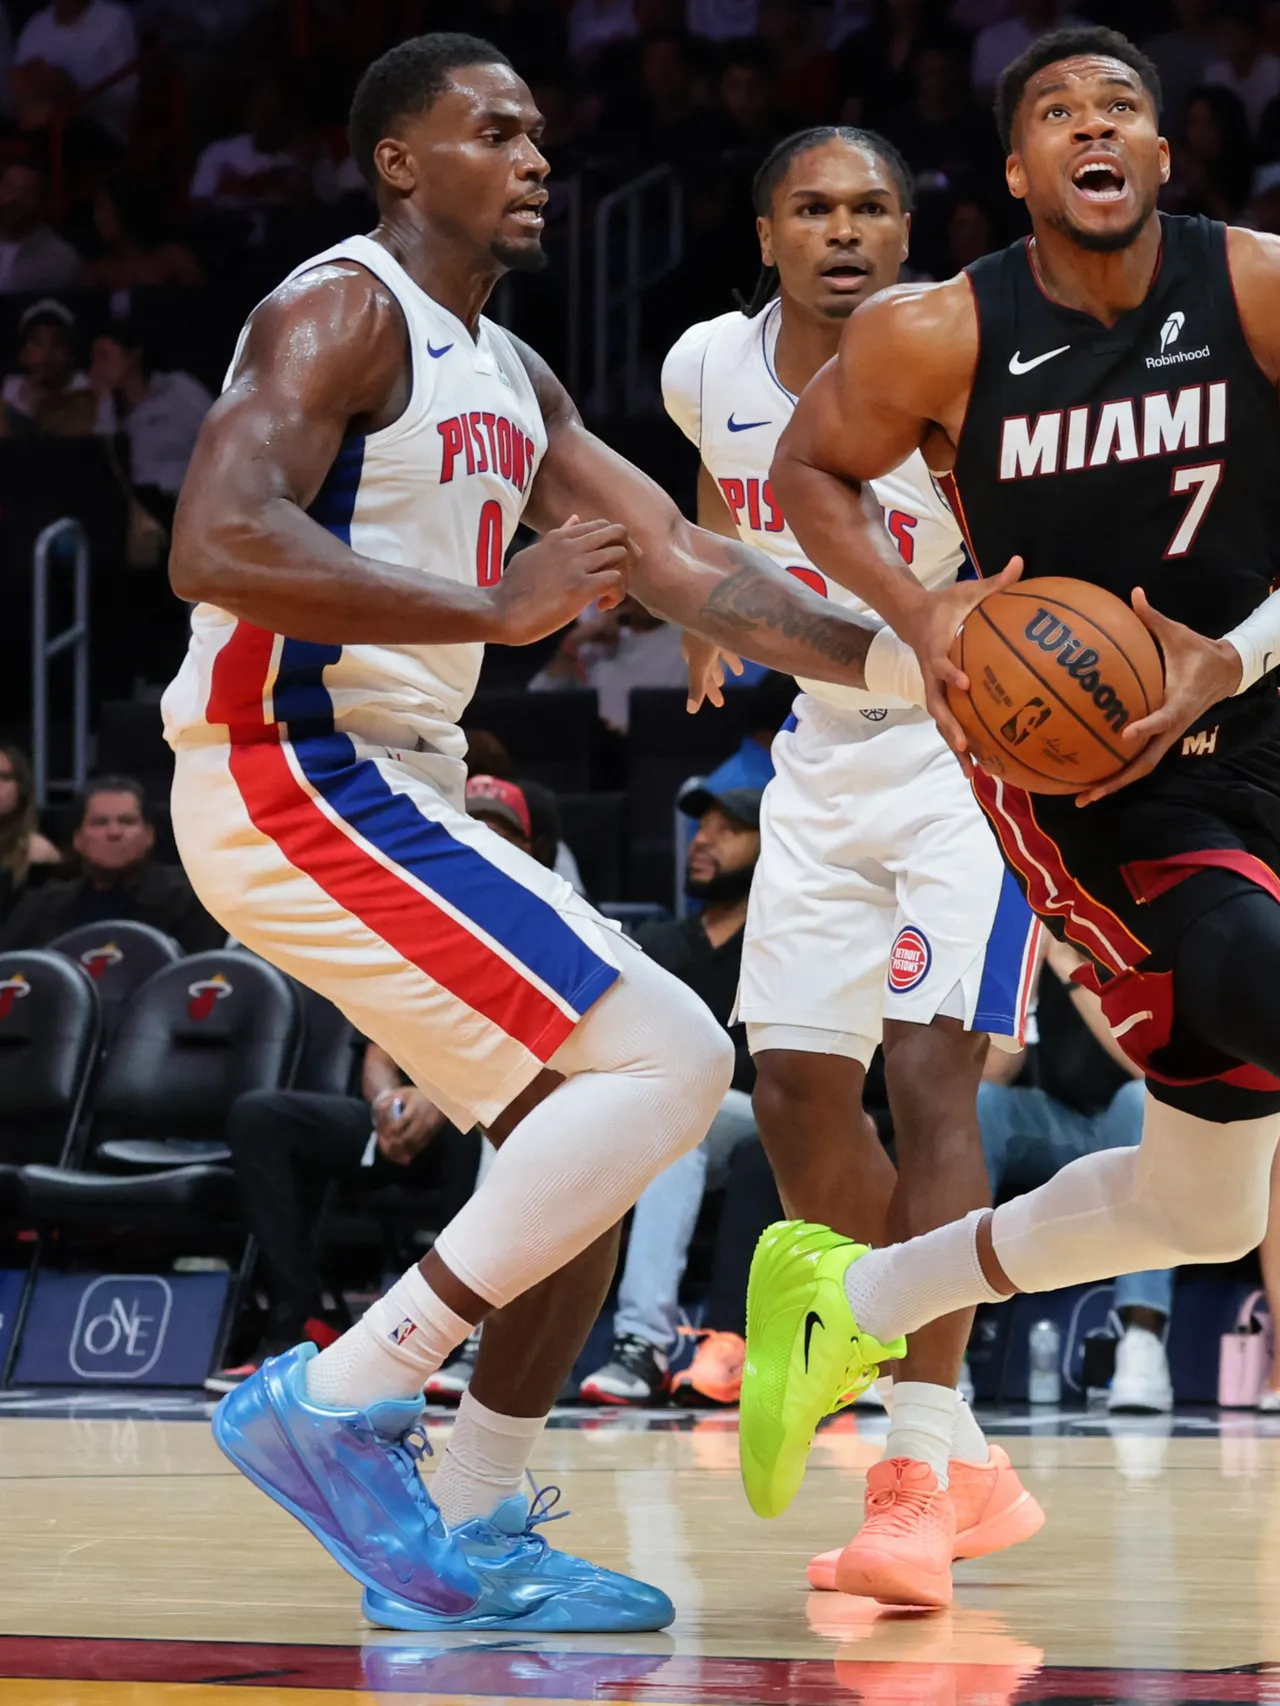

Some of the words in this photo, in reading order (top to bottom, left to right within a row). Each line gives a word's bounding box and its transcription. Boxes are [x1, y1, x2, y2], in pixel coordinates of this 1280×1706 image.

[1145, 345, 1211, 369] Robinhood
[437, 411, 535, 496] PISTONS
[998, 379, 1228, 482] MIAMI
[476, 500, 504, 588] 0
[718, 477, 918, 565] PISS
[1162, 459, 1225, 560] 7
[1024, 607, 1130, 734] Wilson
[892, 959, 919, 973] PISTONS
[895, 947, 921, 962] DETROIT
[84, 1297, 154, 1357] ONE
